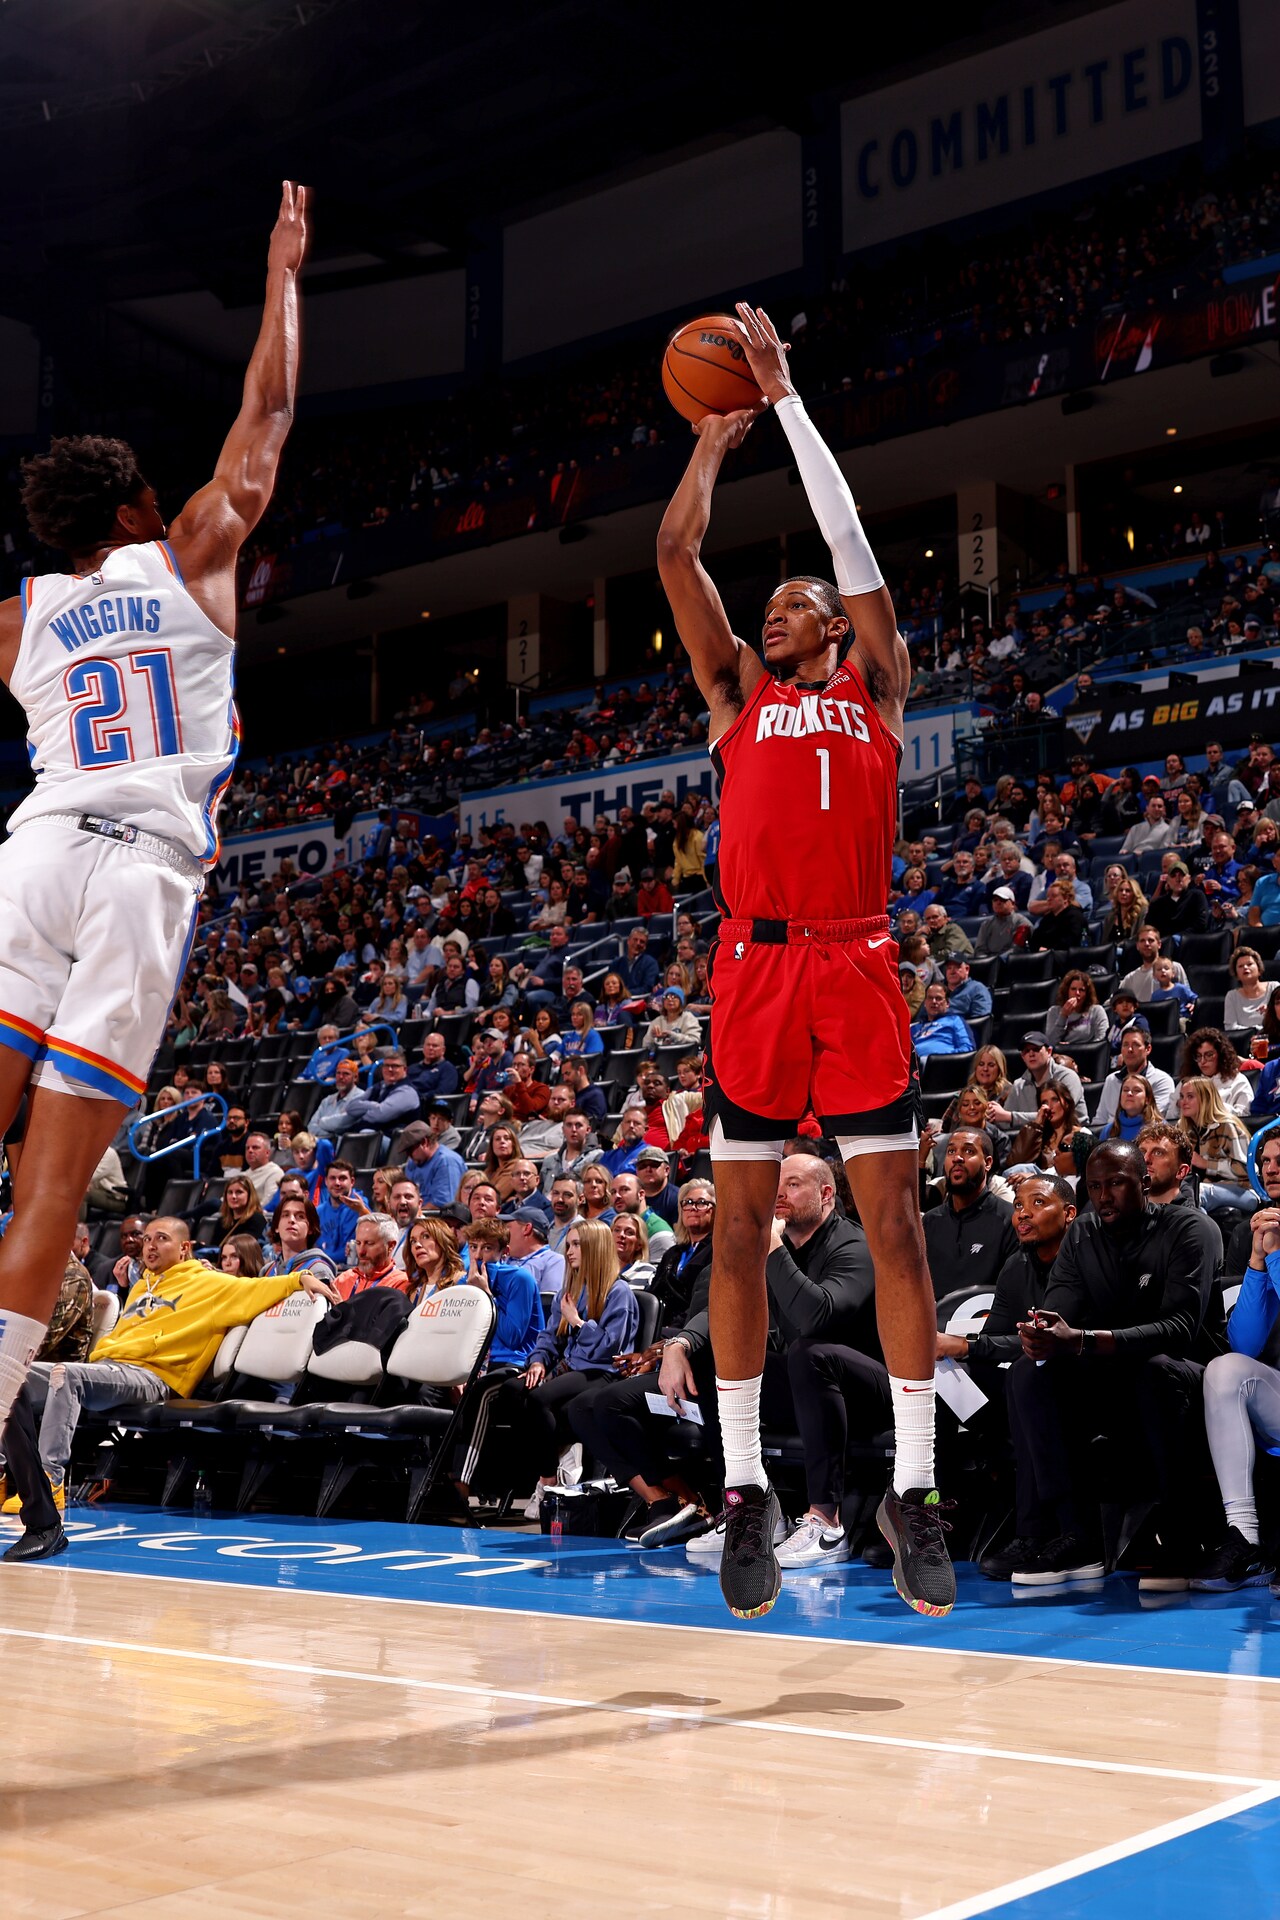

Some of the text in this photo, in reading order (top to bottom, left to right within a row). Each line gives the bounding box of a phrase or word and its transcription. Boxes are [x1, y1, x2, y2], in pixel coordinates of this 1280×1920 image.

[1202, 29, 1220, 98] 323
[858, 36, 1193, 199] COMMITTED
[805, 165, 818, 228] 322
[470, 285, 480, 340] 321
[972, 513, 984, 575] 222
[49, 597, 160, 653] WIGGINS
[519, 620, 528, 674] 221
[63, 648, 184, 770] 21
[755, 694, 871, 743] ROCKETS
[1108, 708, 1146, 734] AS
[1152, 700, 1199, 726] BIG
[1206, 692, 1244, 717] AS
[560, 771, 720, 828] THE H
[816, 748, 830, 810] 1
[273, 840, 328, 875] TO
